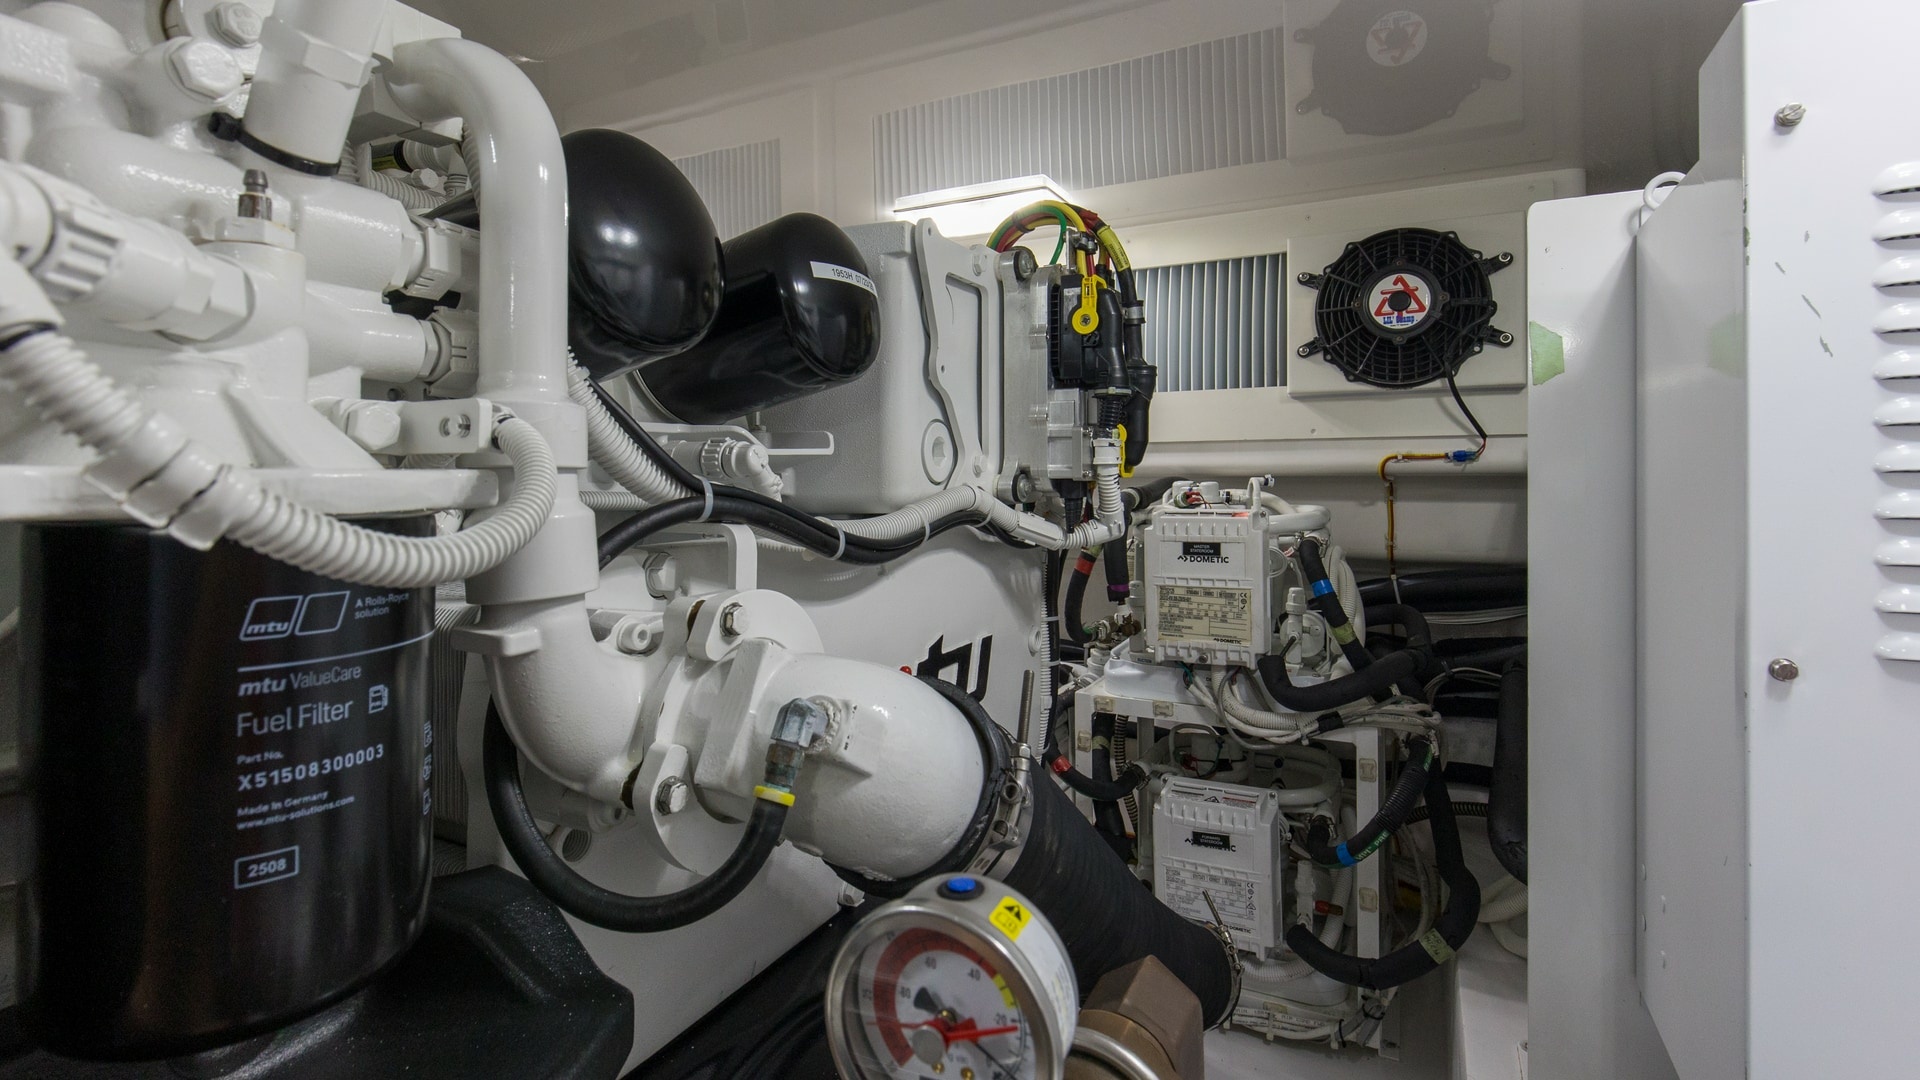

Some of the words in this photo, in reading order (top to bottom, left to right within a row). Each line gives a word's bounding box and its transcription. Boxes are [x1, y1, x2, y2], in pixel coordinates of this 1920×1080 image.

[832, 268, 854, 281] 1953H
[1189, 556, 1229, 564] DOMETIC
[355, 598, 363, 609] A
[354, 606, 390, 620] solution
[246, 621, 289, 635] mtu
[238, 677, 287, 697] mtu
[290, 665, 362, 690] ValueCare
[237, 707, 292, 737] Fuel
[298, 700, 354, 729] Filter
[237, 754, 262, 765] Part
[264, 751, 284, 761] No.
[238, 744, 384, 792] X51508300003
[237, 804, 269, 817] Made
[284, 790, 329, 808] Germany
[248, 858, 287, 878] 2508
[1229, 925, 1252, 934] DOMETIC
